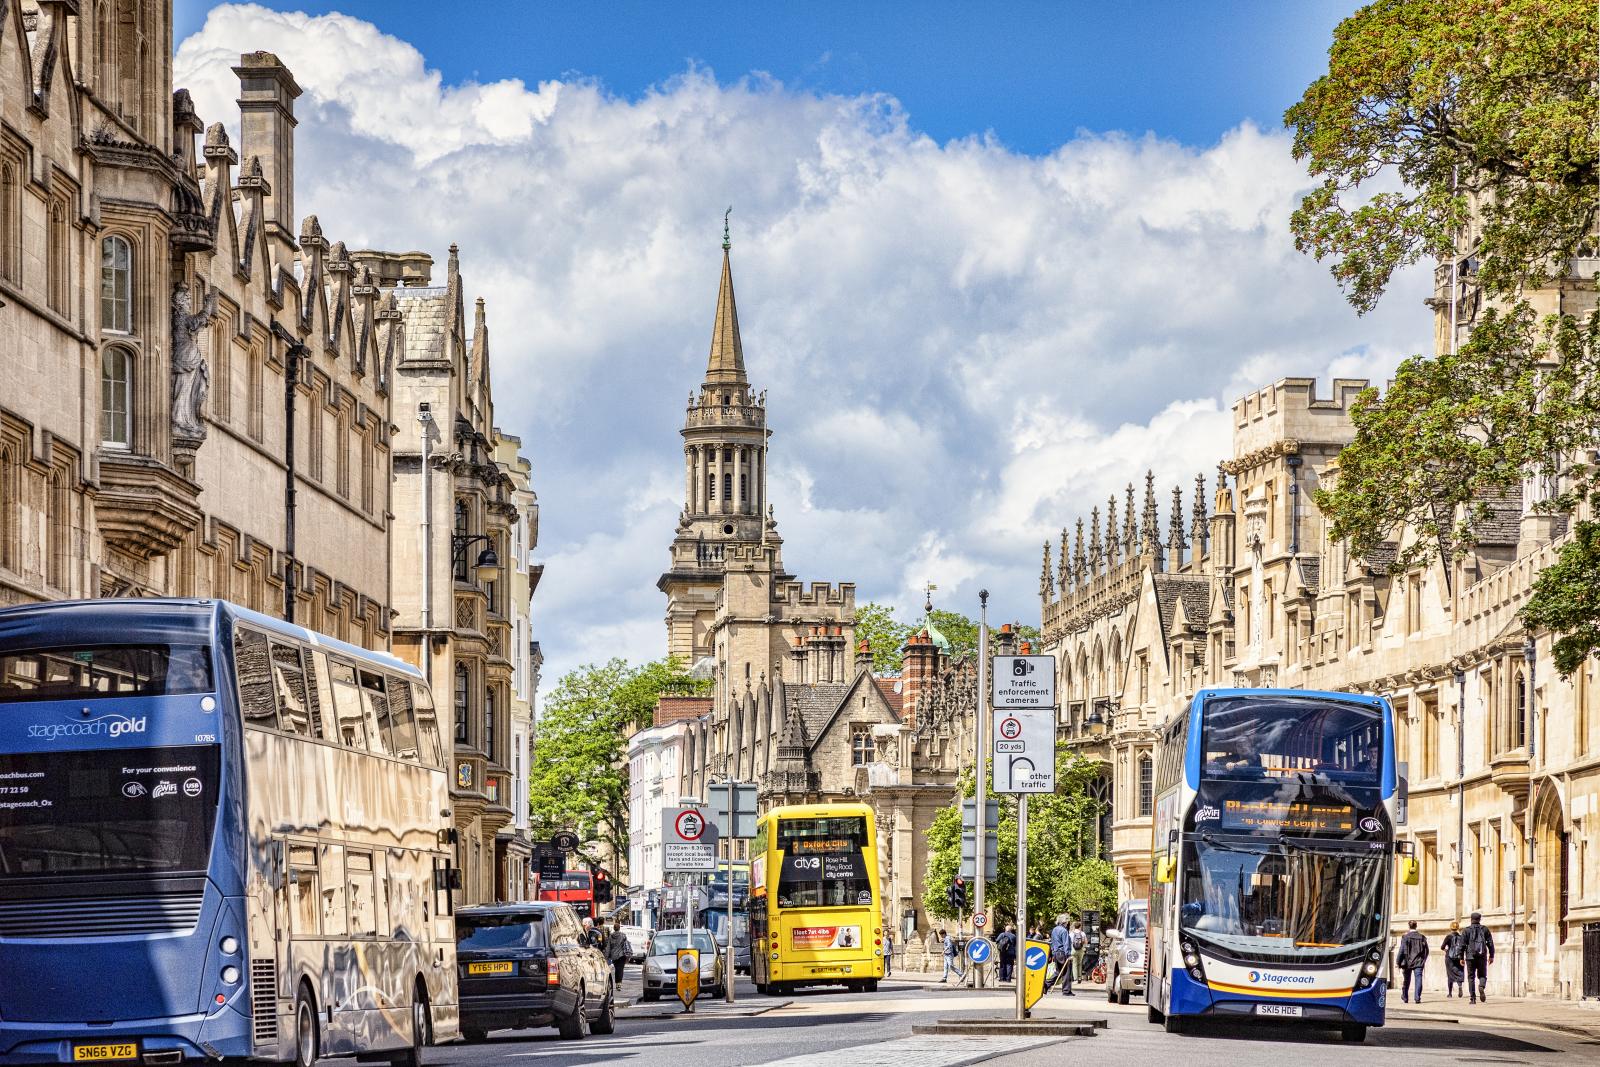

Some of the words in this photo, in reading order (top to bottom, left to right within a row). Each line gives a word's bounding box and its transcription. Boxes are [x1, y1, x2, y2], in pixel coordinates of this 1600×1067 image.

[998, 688, 1049, 696] enforcement
[27, 719, 107, 740] stagecoach
[109, 717, 146, 737] gold
[194, 734, 215, 742] 10785
[1010, 743, 1022, 752] yds
[136, 767, 152, 775] your
[153, 765, 197, 773] convenience
[160, 783, 177, 792] WiFi
[1021, 780, 1046, 788] traffic
[10, 786, 18, 794] 22
[1203, 809, 1220, 817] WiFi
[792, 841, 799, 854] 3
[803, 841, 830, 849] Oxford
[832, 840, 848, 848] City
[975, 916, 985, 924] 20
[1262, 972, 1315, 984] Stagecoach
[1261, 1005, 1280, 1013] SK15
[79, 1047, 107, 1058] SN66
[110, 1045, 131, 1056] VZG
